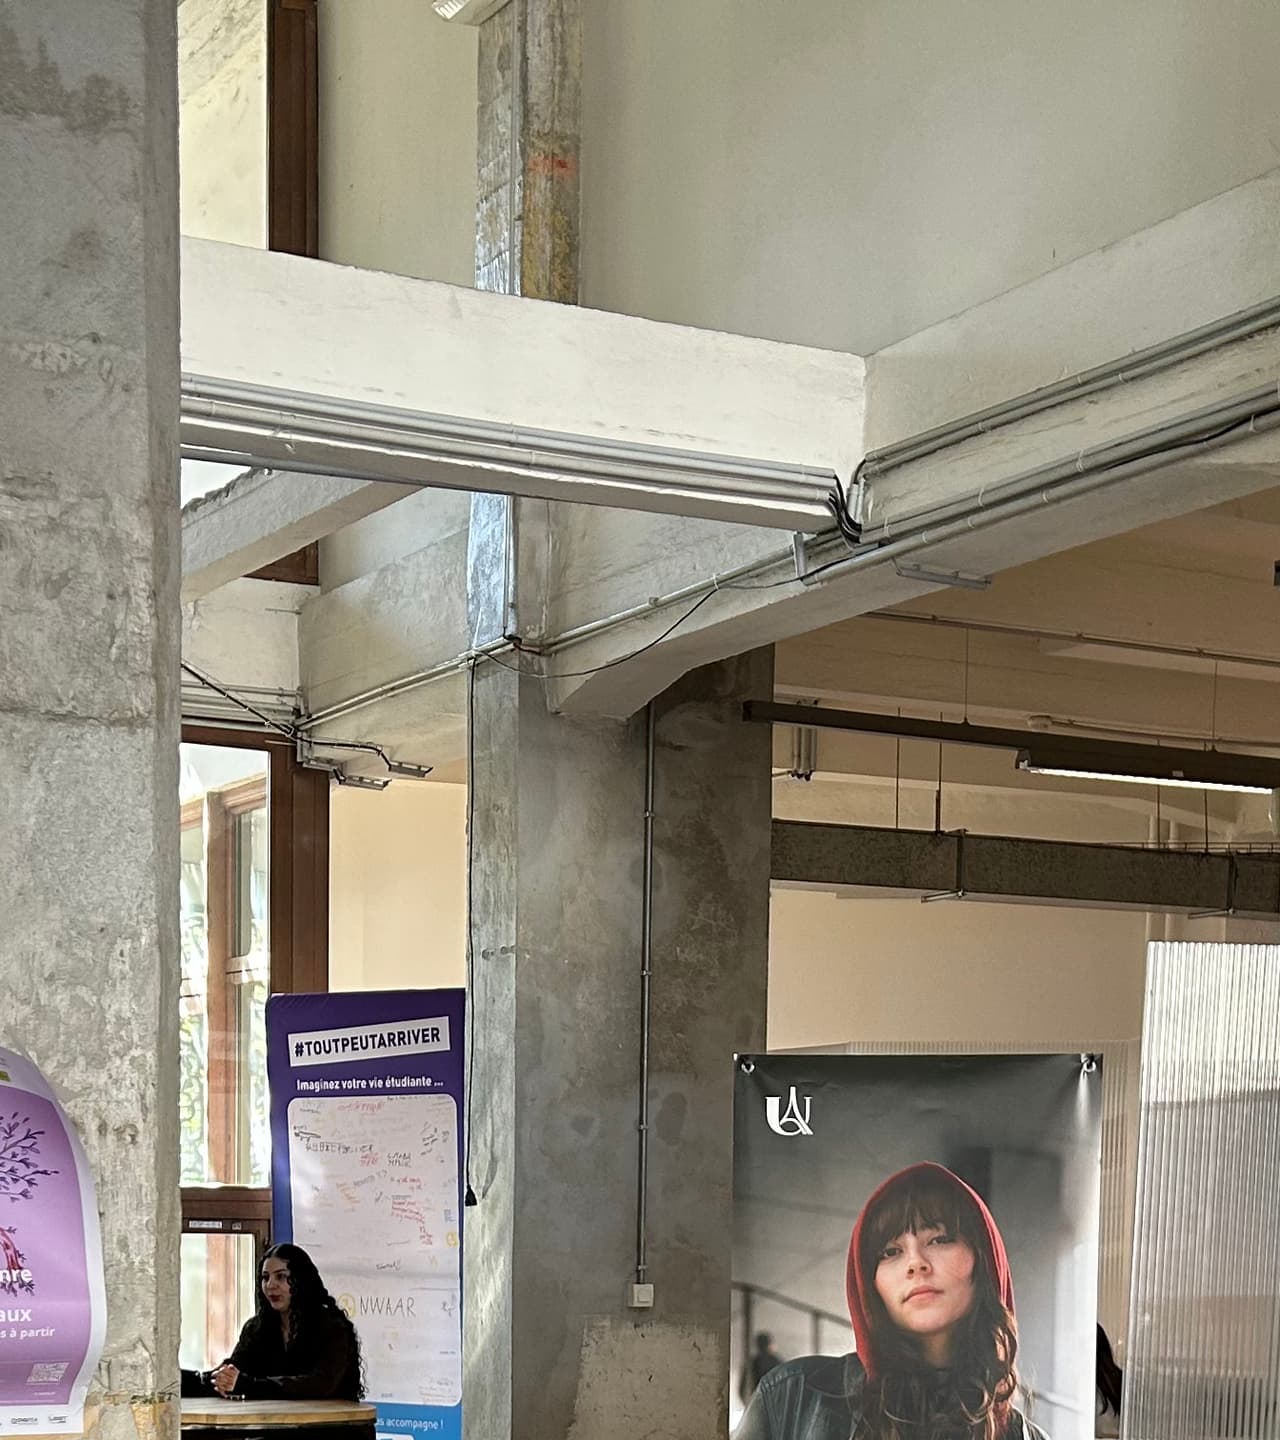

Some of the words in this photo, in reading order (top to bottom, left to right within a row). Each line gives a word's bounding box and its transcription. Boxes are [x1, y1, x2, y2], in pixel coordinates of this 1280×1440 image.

[293, 1026, 442, 1058] #TOUTPEUTARRIVER
[296, 1077, 340, 1092] Imaginez
[341, 1078, 368, 1090] votre
[369, 1077, 384, 1089] vie
[385, 1076, 432, 1088] étudiante
[9, 1327, 18, 1339] à
[19, 1326, 56, 1340] partir
[386, 1418, 439, 1431] accompagne
